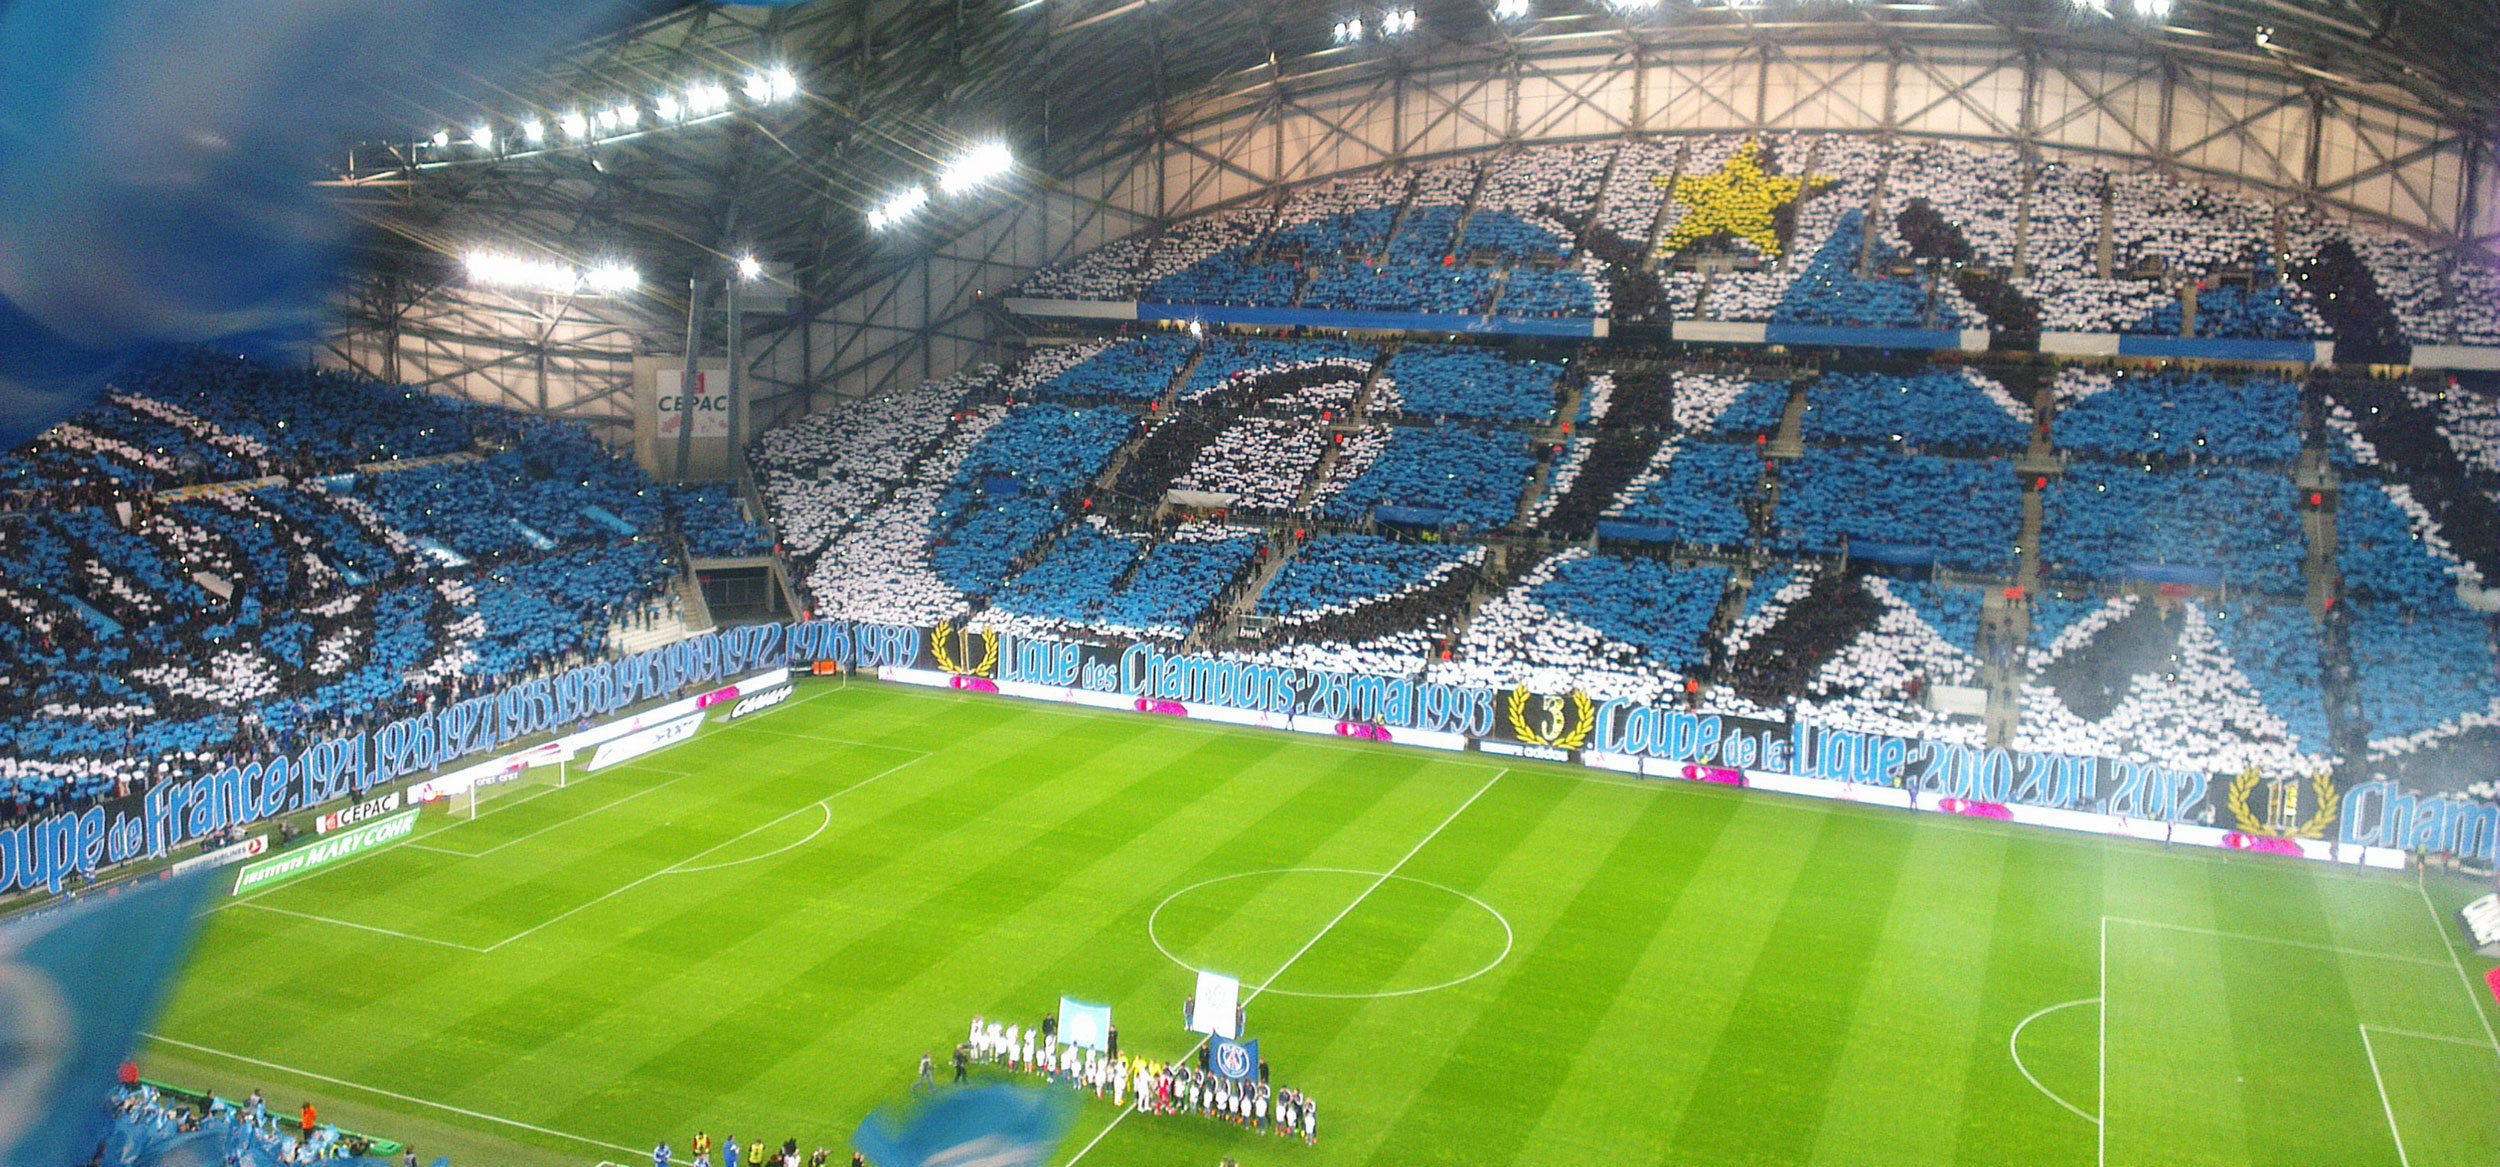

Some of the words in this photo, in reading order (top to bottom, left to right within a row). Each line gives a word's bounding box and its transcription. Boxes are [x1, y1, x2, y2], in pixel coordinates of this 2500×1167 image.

[998, 630, 1080, 688] Ligue
[1082, 656, 1117, 692] des
[1307, 670, 1349, 720] 26
[1350, 675, 1413, 727] mai
[1417, 683, 1494, 737] 1993
[108, 810, 142, 863] de
[852, 622, 920, 669] 1989
[1541, 695, 1565, 741] 3
[1596, 696, 1721, 762] Coupe
[1723, 728, 1756, 768] de
[1762, 730, 1789, 773] la
[2109, 759, 2208, 822] 2012
[341, 795, 391, 824] CEPAC
[2266, 778, 2299, 830] 11
[305, 832, 362, 867] MARY
[363, 815, 414, 847] COHR
